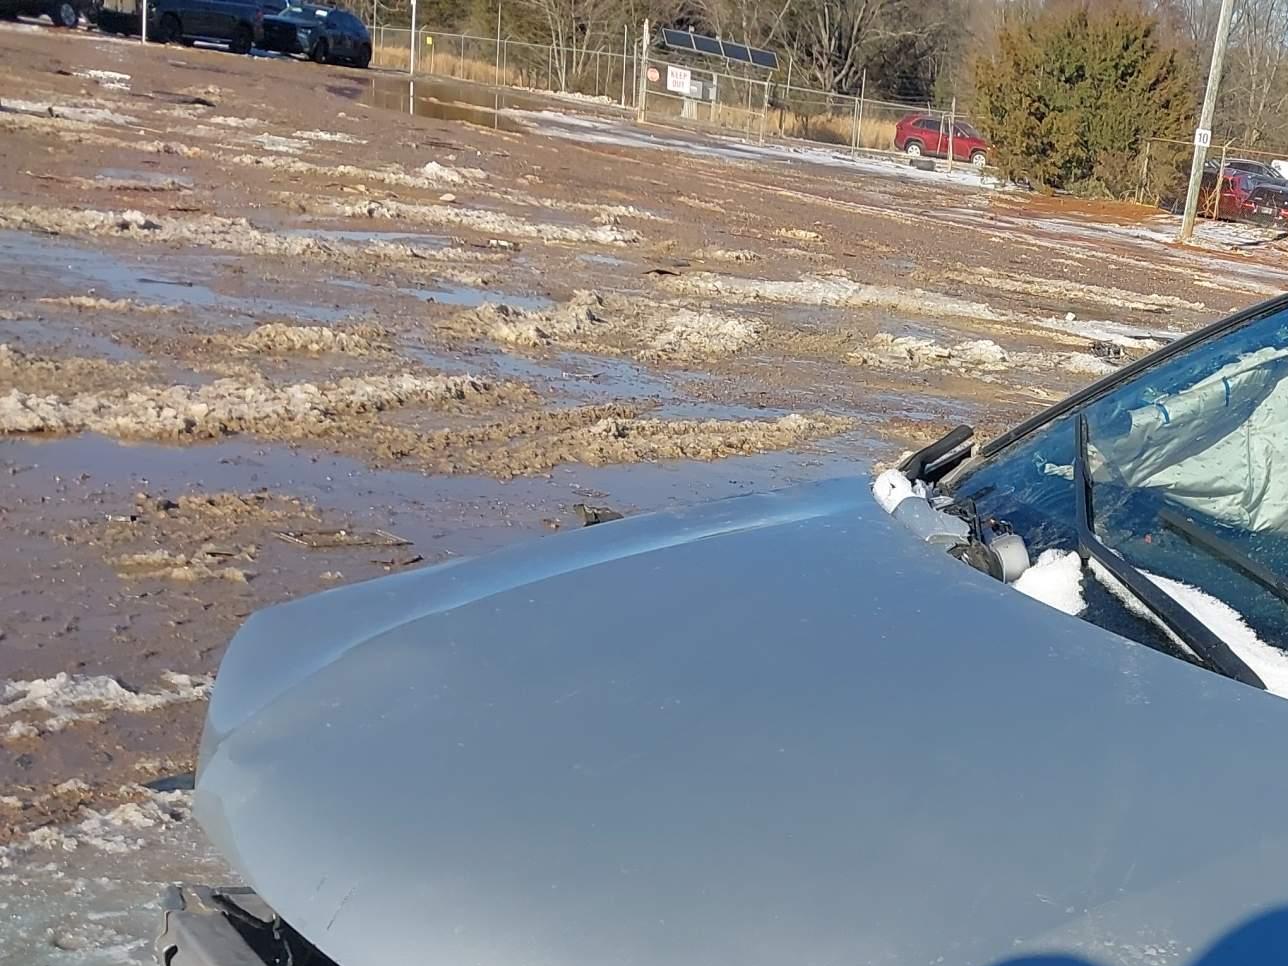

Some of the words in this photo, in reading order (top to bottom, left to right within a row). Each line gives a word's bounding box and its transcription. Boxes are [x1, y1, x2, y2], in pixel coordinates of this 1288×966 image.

[671, 70, 688, 80] KEEP
[672, 80, 686, 88] OUT
[1198, 132, 1209, 144] 10
